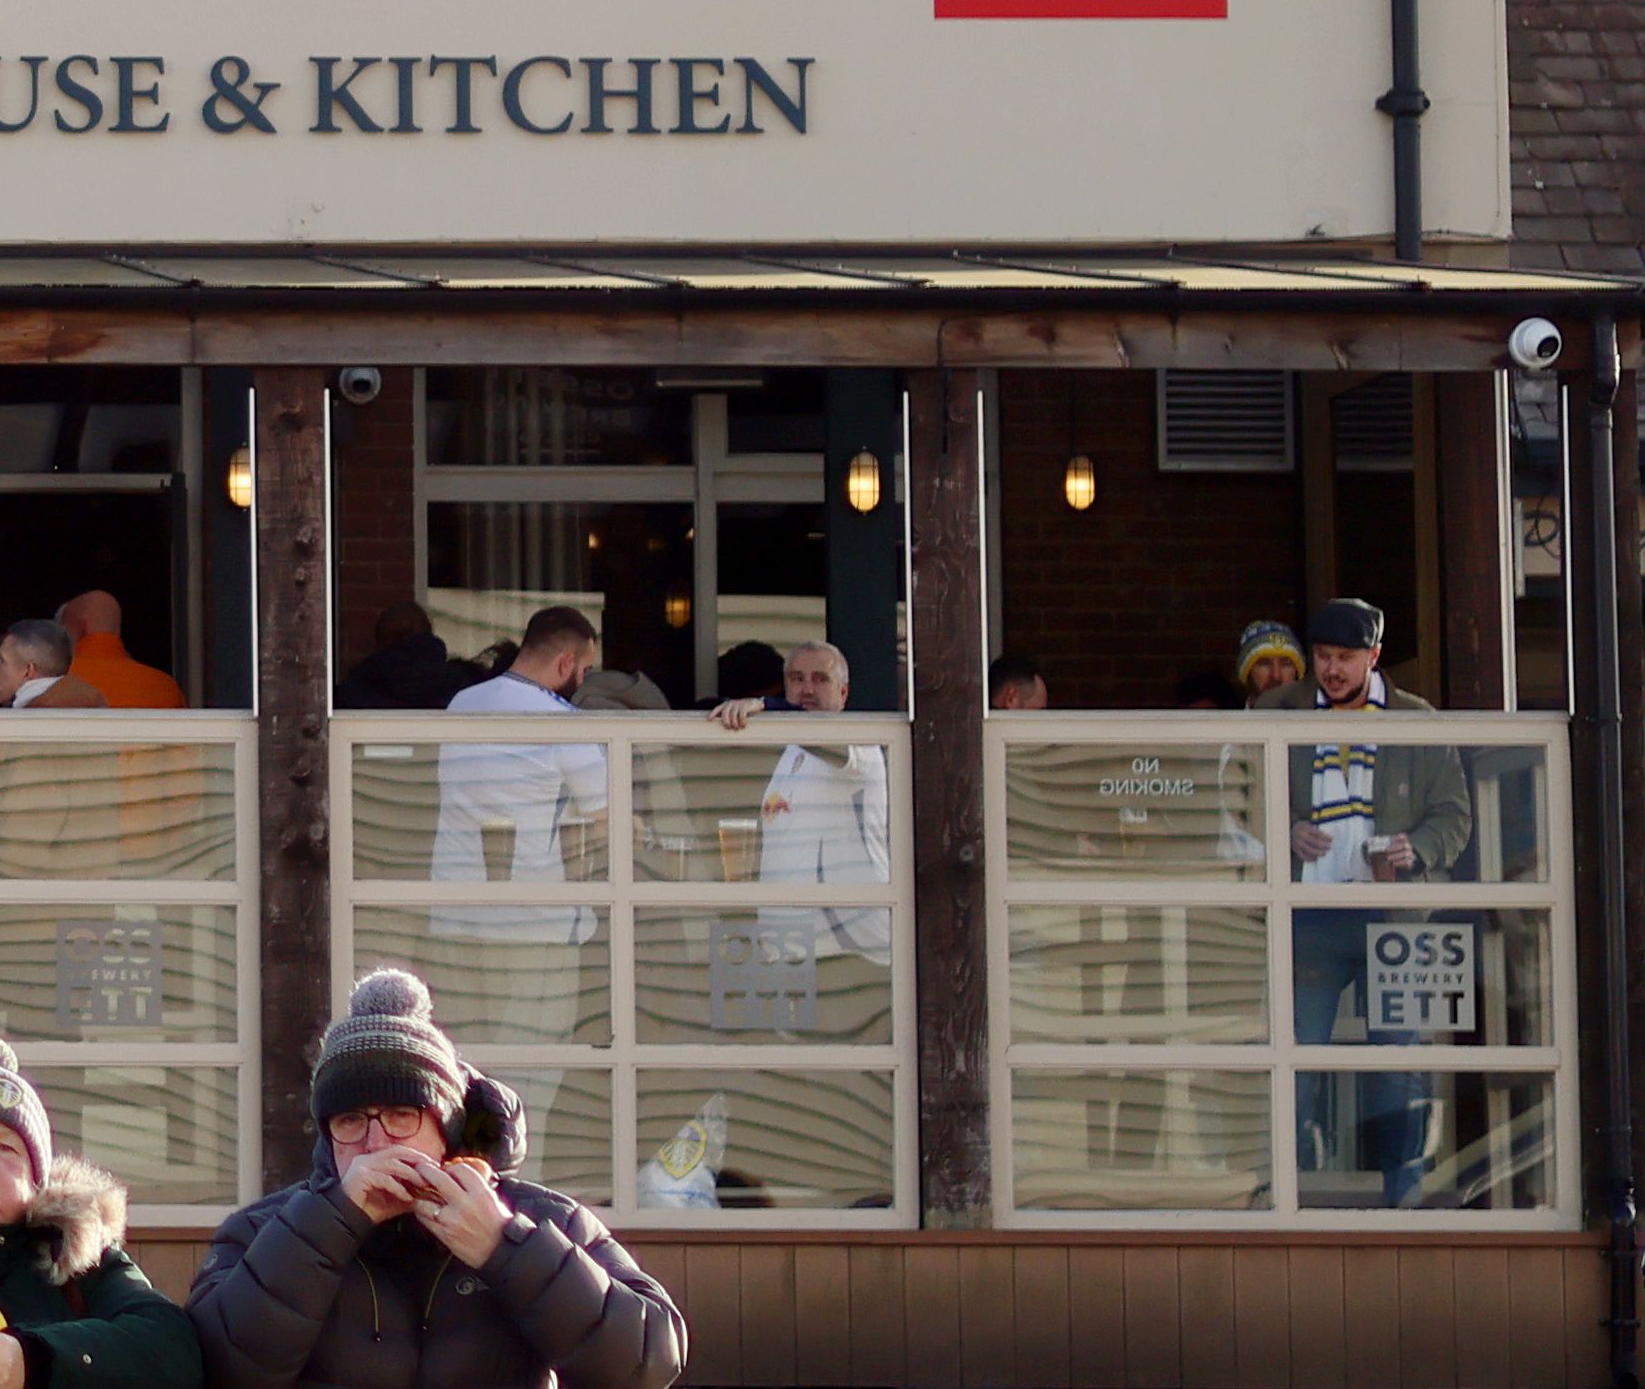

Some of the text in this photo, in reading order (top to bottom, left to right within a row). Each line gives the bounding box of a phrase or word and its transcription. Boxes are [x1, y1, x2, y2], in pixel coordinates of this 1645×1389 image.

[201, 54, 282, 135] &
[307, 54, 816, 135] KITCHEN
[1374, 931, 1465, 967] OSS
[1377, 973, 1464, 984] BREWERY
[1380, 990, 1465, 1024] ETT
